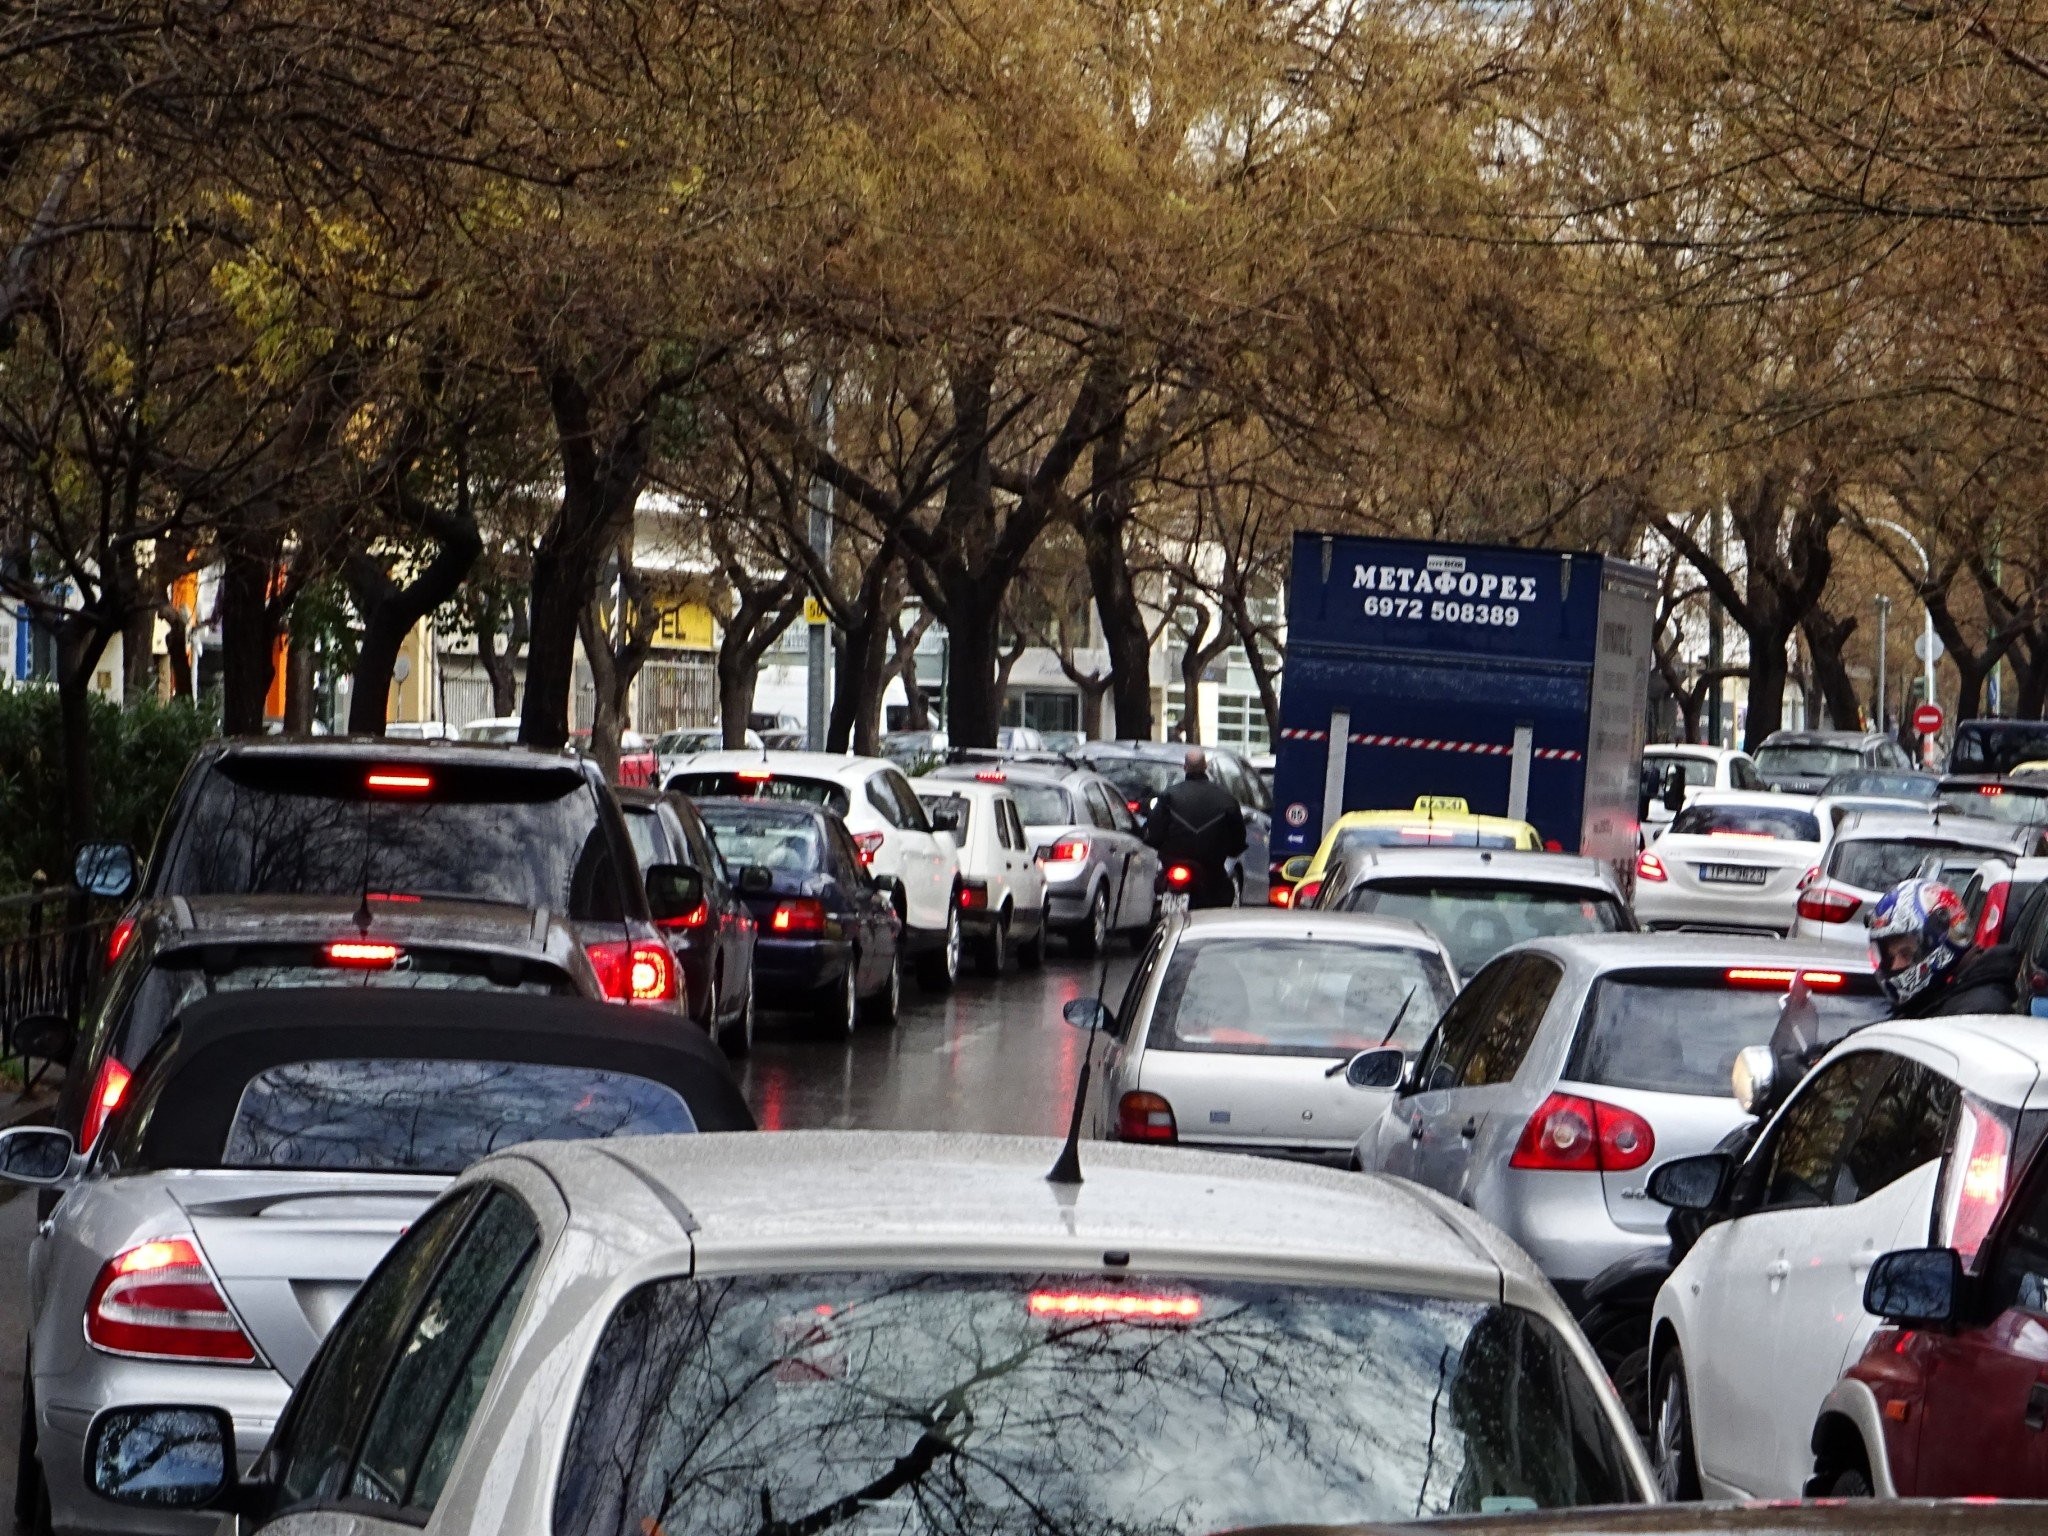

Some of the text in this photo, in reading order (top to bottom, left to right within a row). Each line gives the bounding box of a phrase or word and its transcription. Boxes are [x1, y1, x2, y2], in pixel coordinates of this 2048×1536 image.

[1352, 564, 1537, 602] ΜΕΤΑΦΟΡΕΣ
[1364, 596, 1520, 627] 6972 508389
